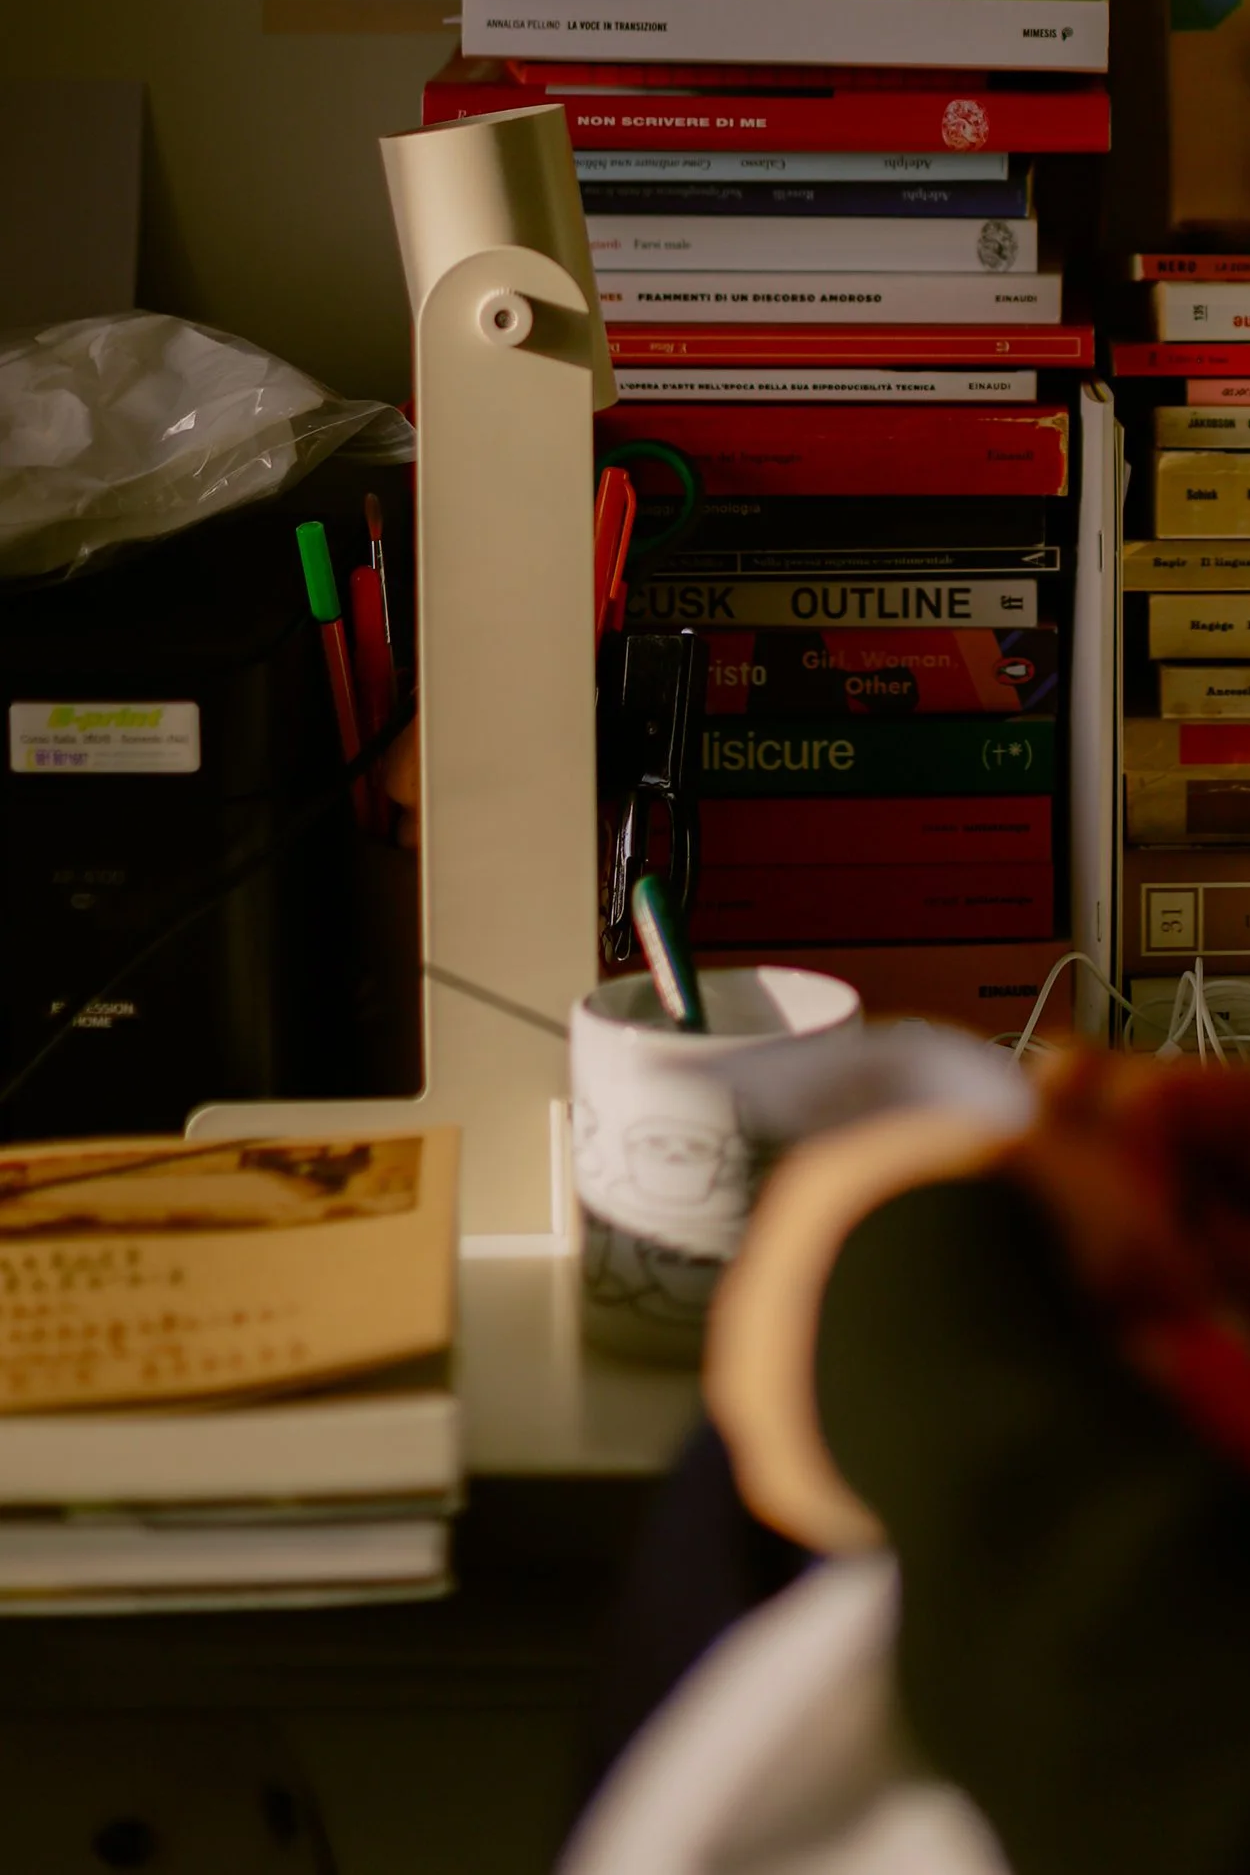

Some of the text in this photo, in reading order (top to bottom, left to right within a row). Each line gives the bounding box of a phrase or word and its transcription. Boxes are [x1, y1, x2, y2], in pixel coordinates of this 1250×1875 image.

[486, 19, 668, 33] ANNALISA PELLINO LA VOCE IN TRANSIZIONE
[1022, 28, 1058, 39] MIMESIS
[577, 116, 768, 129] NON SCRIVERE DI ME
[610, 160, 633, 168] una
[635, 159, 680, 169] ordinare
[682, 160, 711, 171] Come
[741, 159, 787, 171] Calasso
[883, 157, 933, 171] Adelphi
[902, 186, 952, 203] Adelphi
[634, 240, 691, 250] Farsi male
[1157, 260, 1196, 273] NERO
[638, 293, 882, 303] FRAMMENTI DI UN DISCORSO AMOROSO
[994, 294, 1038, 303] EINAUDI
[812, 382, 893, 391] RIPRODUCIBILITÀ
[968, 382, 1012, 391] EINAUDI
[1187, 418, 1236, 429] JAKOBSON
[987, 449, 1034, 462] Einaudi
[1153, 556, 1188, 568] Sapir
[1200, 557, 1211, 567] Il
[790, 587, 973, 620] OUTLINE
[802, 650, 959, 673] Girl, Woman,
[708, 662, 768, 688] risto
[844, 677, 913, 697] Other
[701, 732, 856, 772] lisicure
[1160, 905, 1183, 934] 31
[979, 984, 1038, 999] EINAUDI
[72, 1017, 113, 1029] HOME
